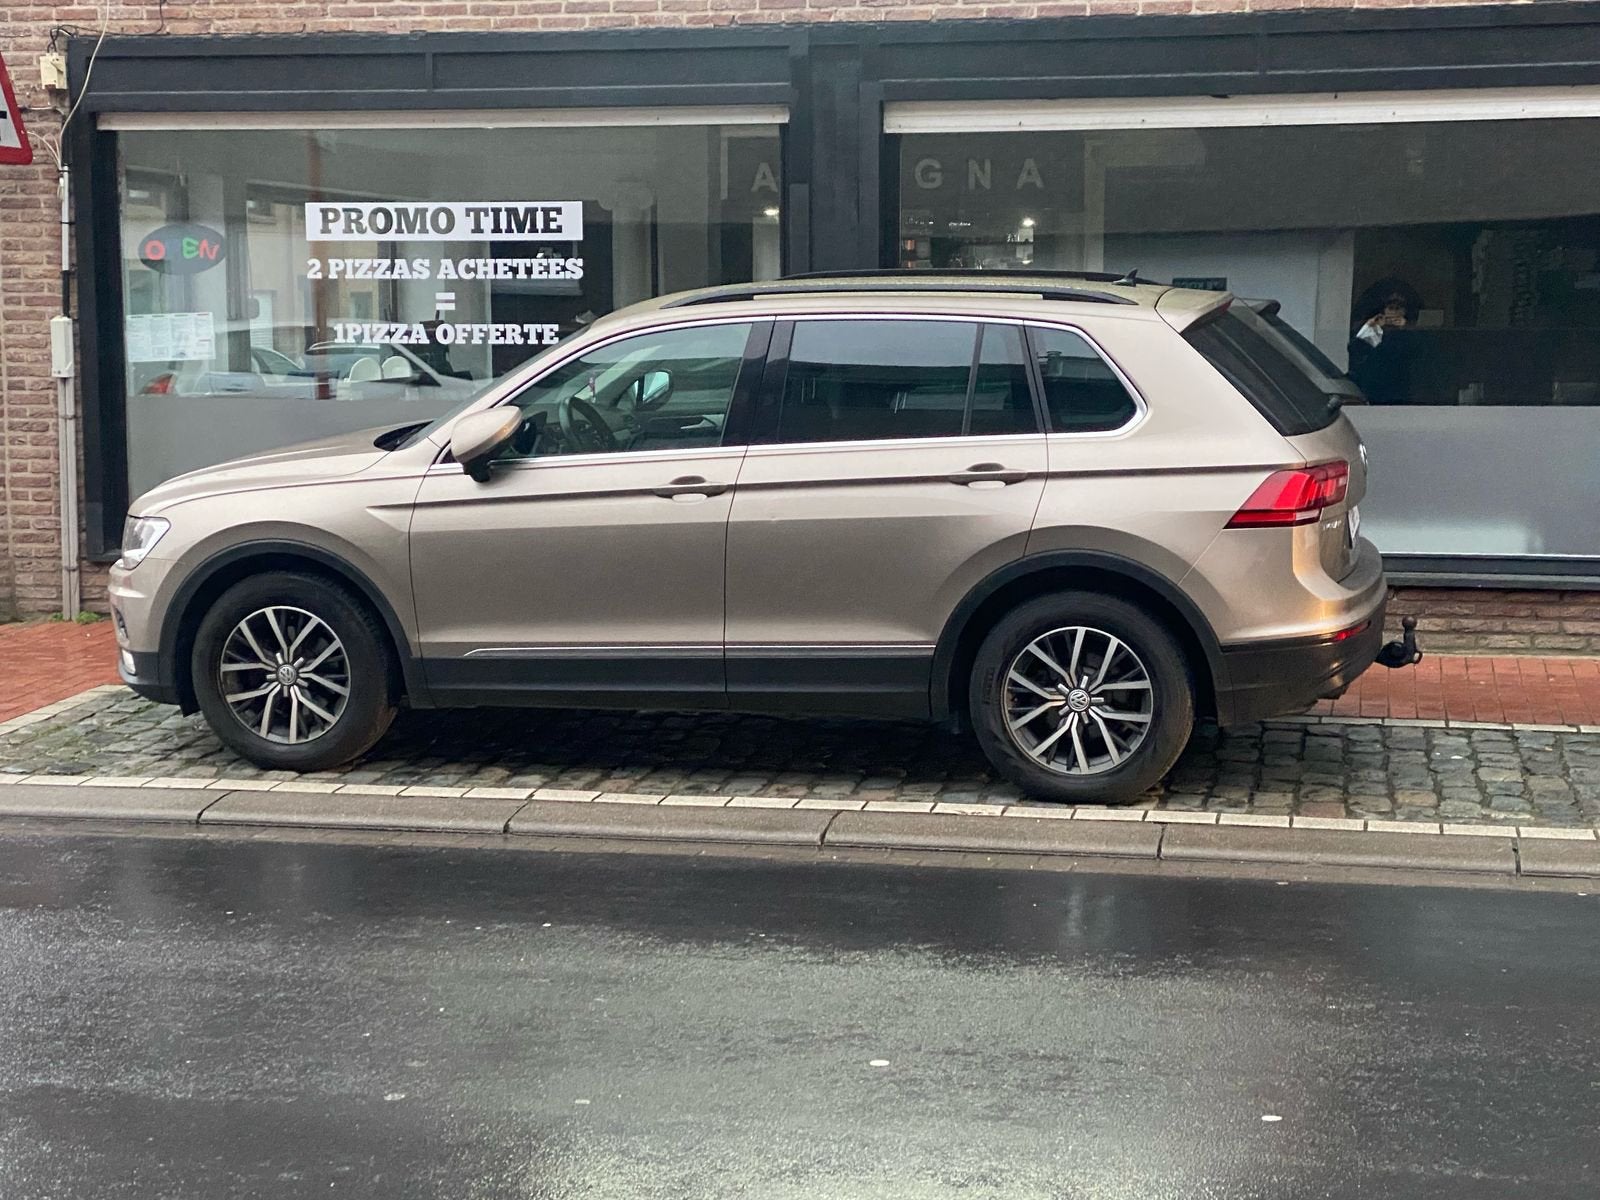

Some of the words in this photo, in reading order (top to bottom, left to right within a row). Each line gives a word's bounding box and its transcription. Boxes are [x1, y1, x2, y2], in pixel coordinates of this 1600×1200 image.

[319, 206, 456, 235] PROMO
[465, 206, 564, 235] TIME
[144, 237, 220, 261] OEN
[306, 258, 323, 280] 2
[328, 258, 431, 280] PIZZAS
[437, 252, 584, 280] ACHETÉES
[333, 323, 430, 345] 1PIZZA
[436, 323, 560, 345] OFFERTE
